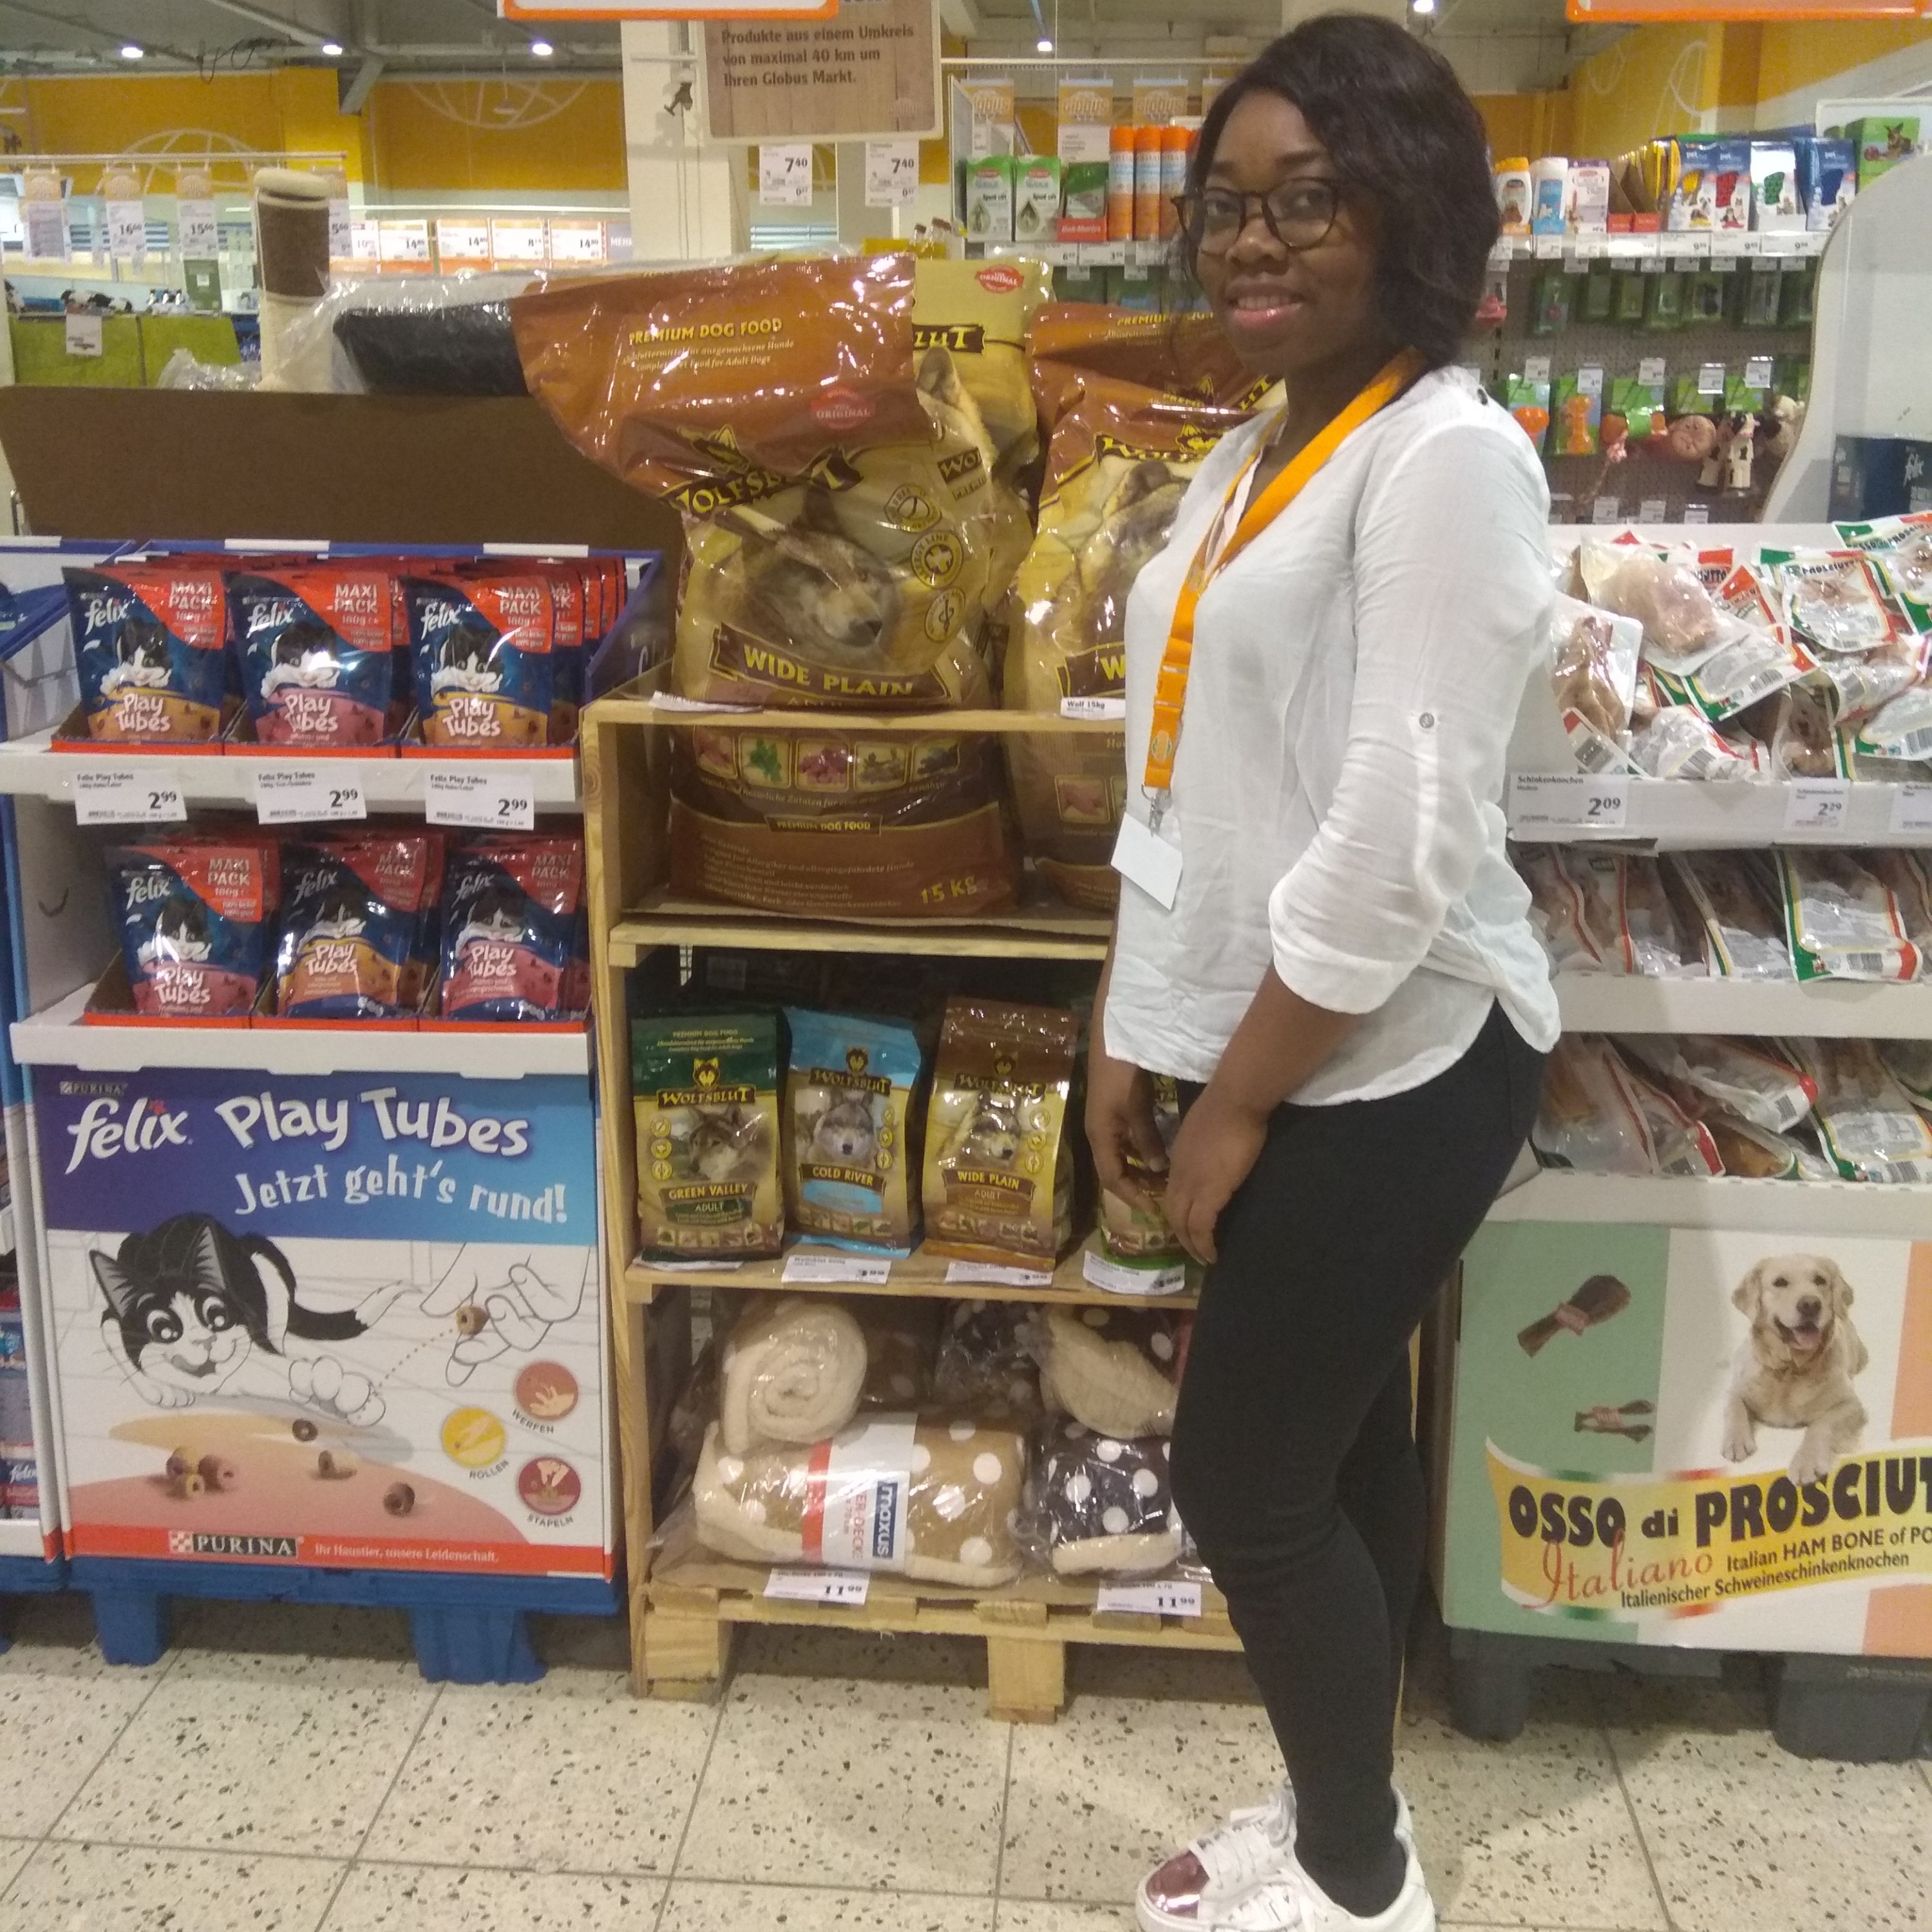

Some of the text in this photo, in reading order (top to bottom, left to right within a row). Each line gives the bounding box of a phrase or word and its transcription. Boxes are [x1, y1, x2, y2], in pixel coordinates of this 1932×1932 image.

[721, 23, 914, 43] Produkte aus einem Umkreis
[723, 48, 880, 66] von maximal 40 km um
[724, 70, 857, 86] Ihren Globus Markt.
[629, 317, 782, 345] PREMIUM DOG FOOD
[816, 407, 872, 419] ORIGINAL
[335, 583, 377, 599] MAXI
[168, 595, 213, 611] PACK
[334, 598, 379, 614] PACK
[500, 598, 542, 615] PACK
[84, 598, 129, 636] felix
[247, 602, 296, 639] felix
[421, 599, 464, 641] felix
[744, 644, 914, 696] WIDE PLAIN
[124, 693, 164, 717] Play
[285, 694, 332, 717] Play
[448, 696, 497, 718] Play
[114, 709, 171, 734] Tubes
[283, 712, 339, 734] Tubes
[442, 714, 501, 737] Tubes
[450, 775, 464, 784] Play
[467, 775, 488, 784] Tubes
[820, 822, 842, 831] DOG
[844, 821, 871, 831] FOOD
[209, 858, 250, 871] MAXI
[531, 866, 570, 880] PACK
[207, 871, 251, 887] PACK
[294, 869, 338, 906] felix
[126, 876, 171, 911] felix
[451, 873, 496, 909] felix
[921, 883, 945, 904] 15
[316, 943, 355, 963] Play
[471, 943, 515, 963] Play
[164, 966, 204, 989] Play
[305, 958, 358, 976] Tubes
[468, 960, 517, 980] Tubes
[154, 984, 211, 1005] Tubes
[662, 1086, 750, 1106] WOLFSBLUT
[214, 1086, 531, 1157] Play Tubes
[65, 1097, 187, 1174] felix
[812, 1166, 874, 1187] COLD RIVER
[957, 1171, 1019, 1190] WIDE PLAIN
[234, 1153, 569, 1224] Jetzt geht's rund!
[668, 1182, 748, 1200] GREEN VALLEY
[695, 1202, 723, 1212] ADULT
[512, 1408, 554, 1434] WERFEN
[469, 1459, 509, 1479] ROLLEN
[526, 1514, 574, 1529] STAPELN
[876, 1486, 893, 1557] maxus
[1508, 1485, 1627, 1548] OSSO
[1641, 1506, 1680, 1539] di
[196, 1535, 295, 1557] PURINA
[315, 1542, 332, 1555] Ihr
[334, 1544, 383, 1558] Haustier,
[386, 1546, 422, 1559] unsere
[1727, 1549, 1777, 1572] Italian
[1783, 1537, 1826, 1561] HAM
[1832, 1528, 1885, 1552] BONE
[1889, 1526, 1907, 1544] of
[1522, 1529, 1714, 1609] Italiano
[1621, 1550, 1910, 1609] Italienischer Schweineschinkenknochen
